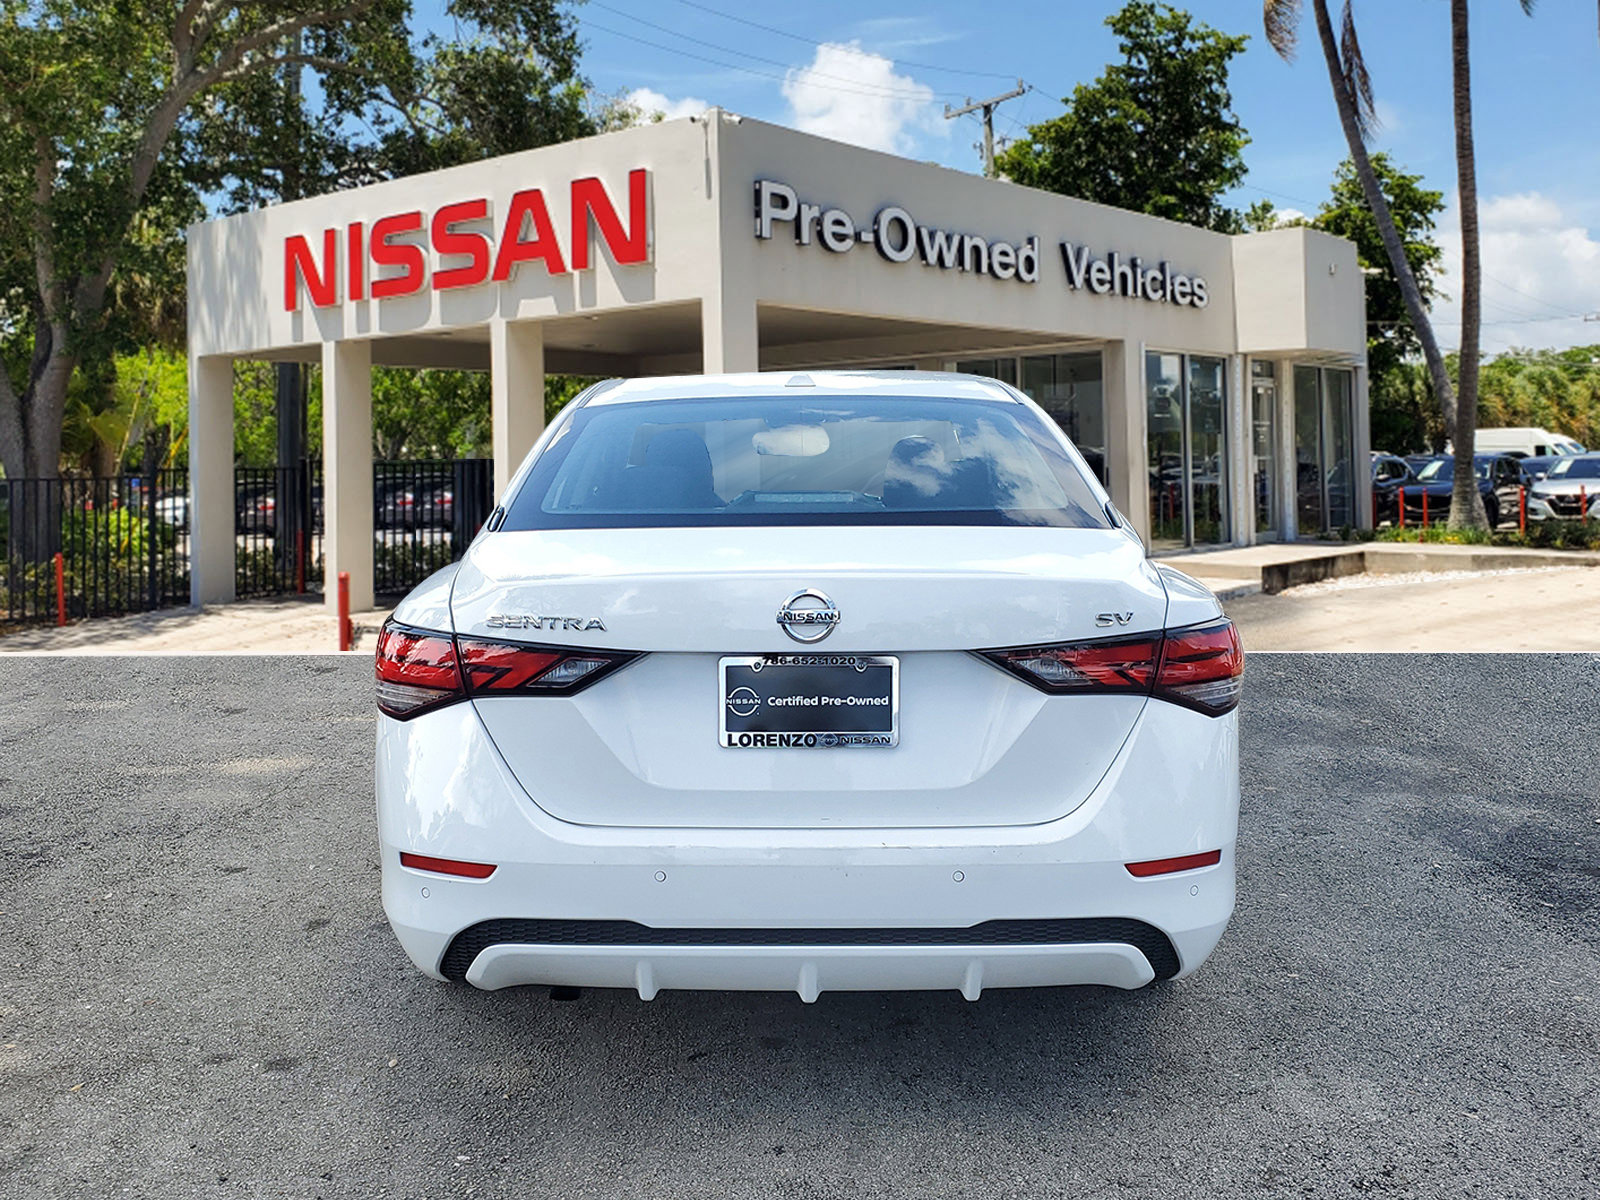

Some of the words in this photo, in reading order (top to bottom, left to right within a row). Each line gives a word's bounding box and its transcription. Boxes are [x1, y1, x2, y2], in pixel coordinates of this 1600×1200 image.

[285, 168, 650, 312] NISSAN
[754, 180, 1040, 284] Pre-Owned
[1060, 240, 1208, 308] Vehicles
[486, 614, 607, 632] SENTRA
[783, 612, 834, 621] NISSAN
[1095, 612, 1134, 628] SV
[762, 656, 857, 666] 786-652-1020
[767, 696, 819, 707] Certified
[821, 695, 889, 707] Pre-Owned
[727, 733, 818, 747] LORENZO
[840, 735, 891, 745] NISSAN
